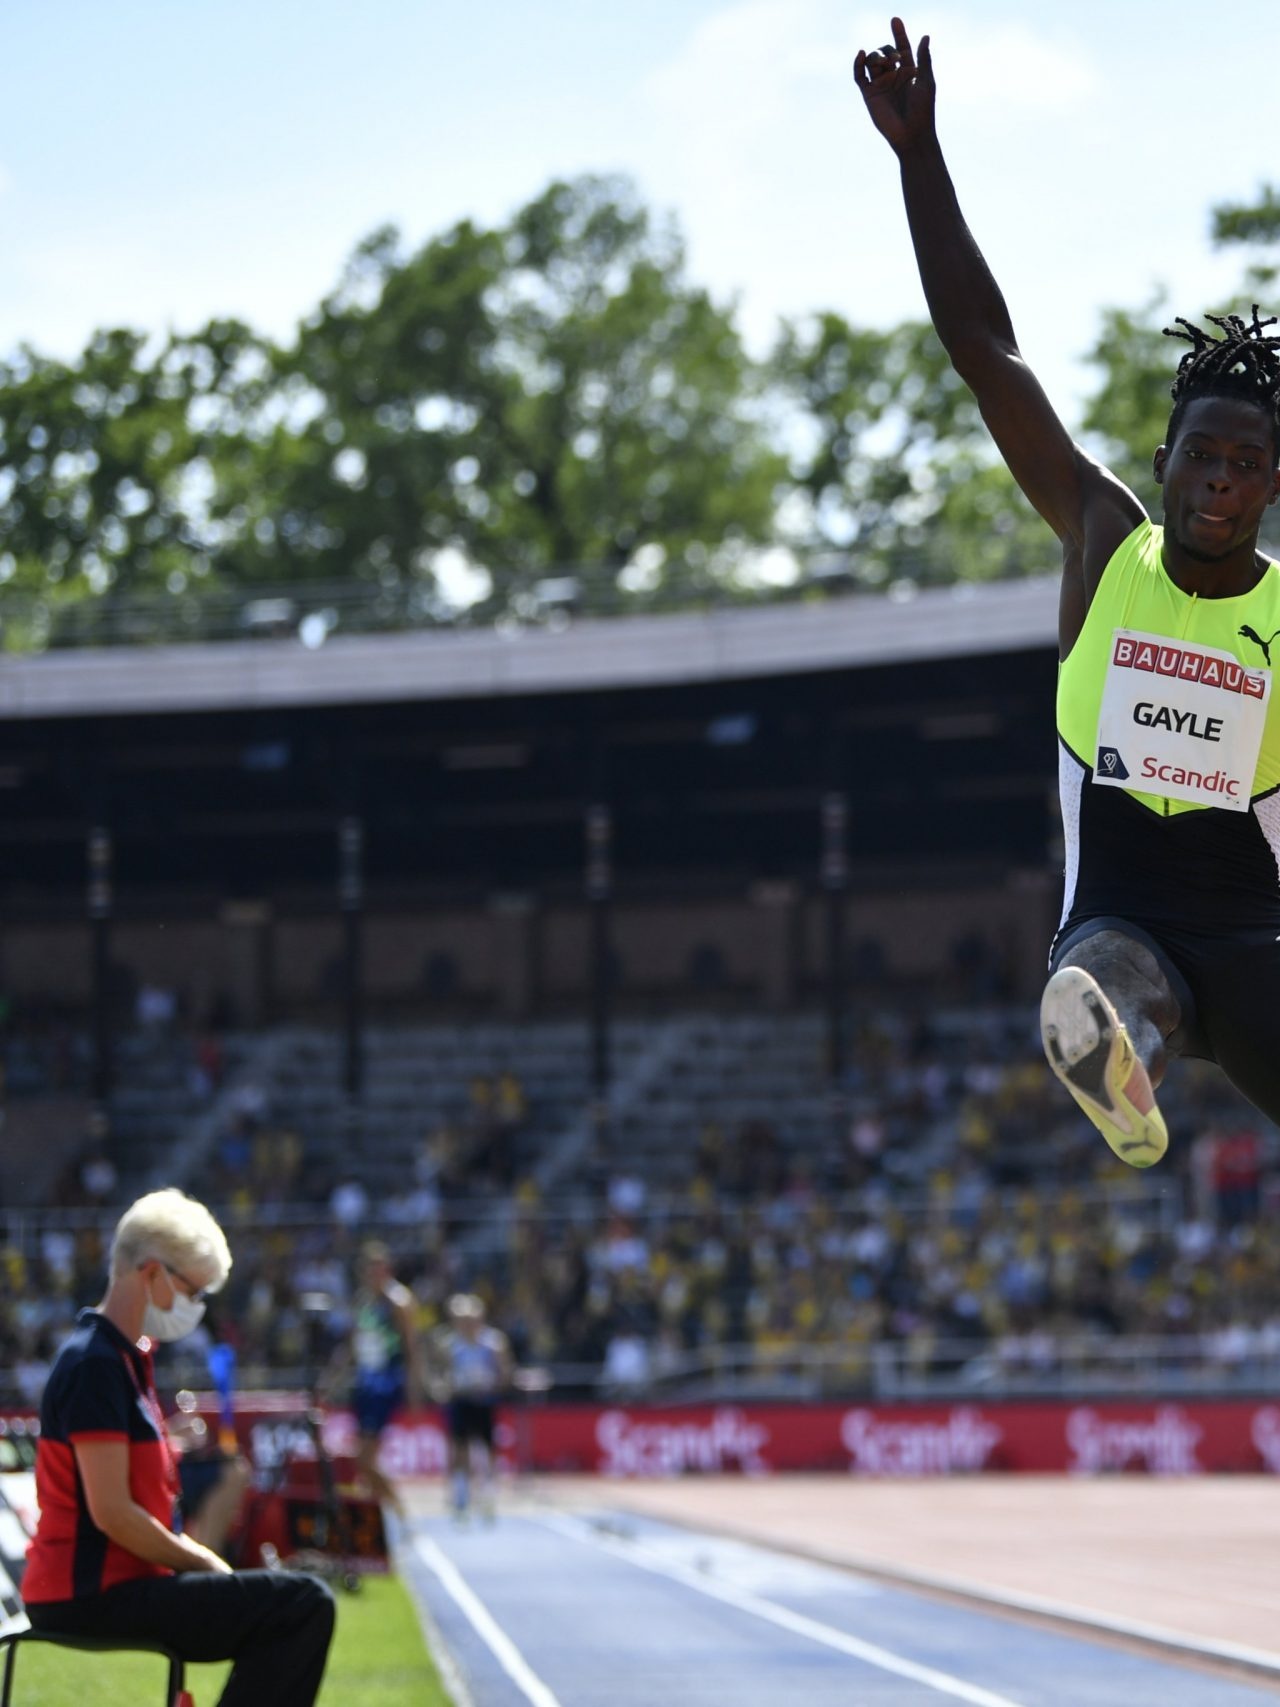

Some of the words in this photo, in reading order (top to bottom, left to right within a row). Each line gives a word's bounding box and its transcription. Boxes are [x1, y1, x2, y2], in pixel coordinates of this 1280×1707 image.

[1115, 641, 1263, 695] BAUHAUS
[1133, 702, 1224, 742] GAYLE
[1140, 756, 1240, 796] Scandic
